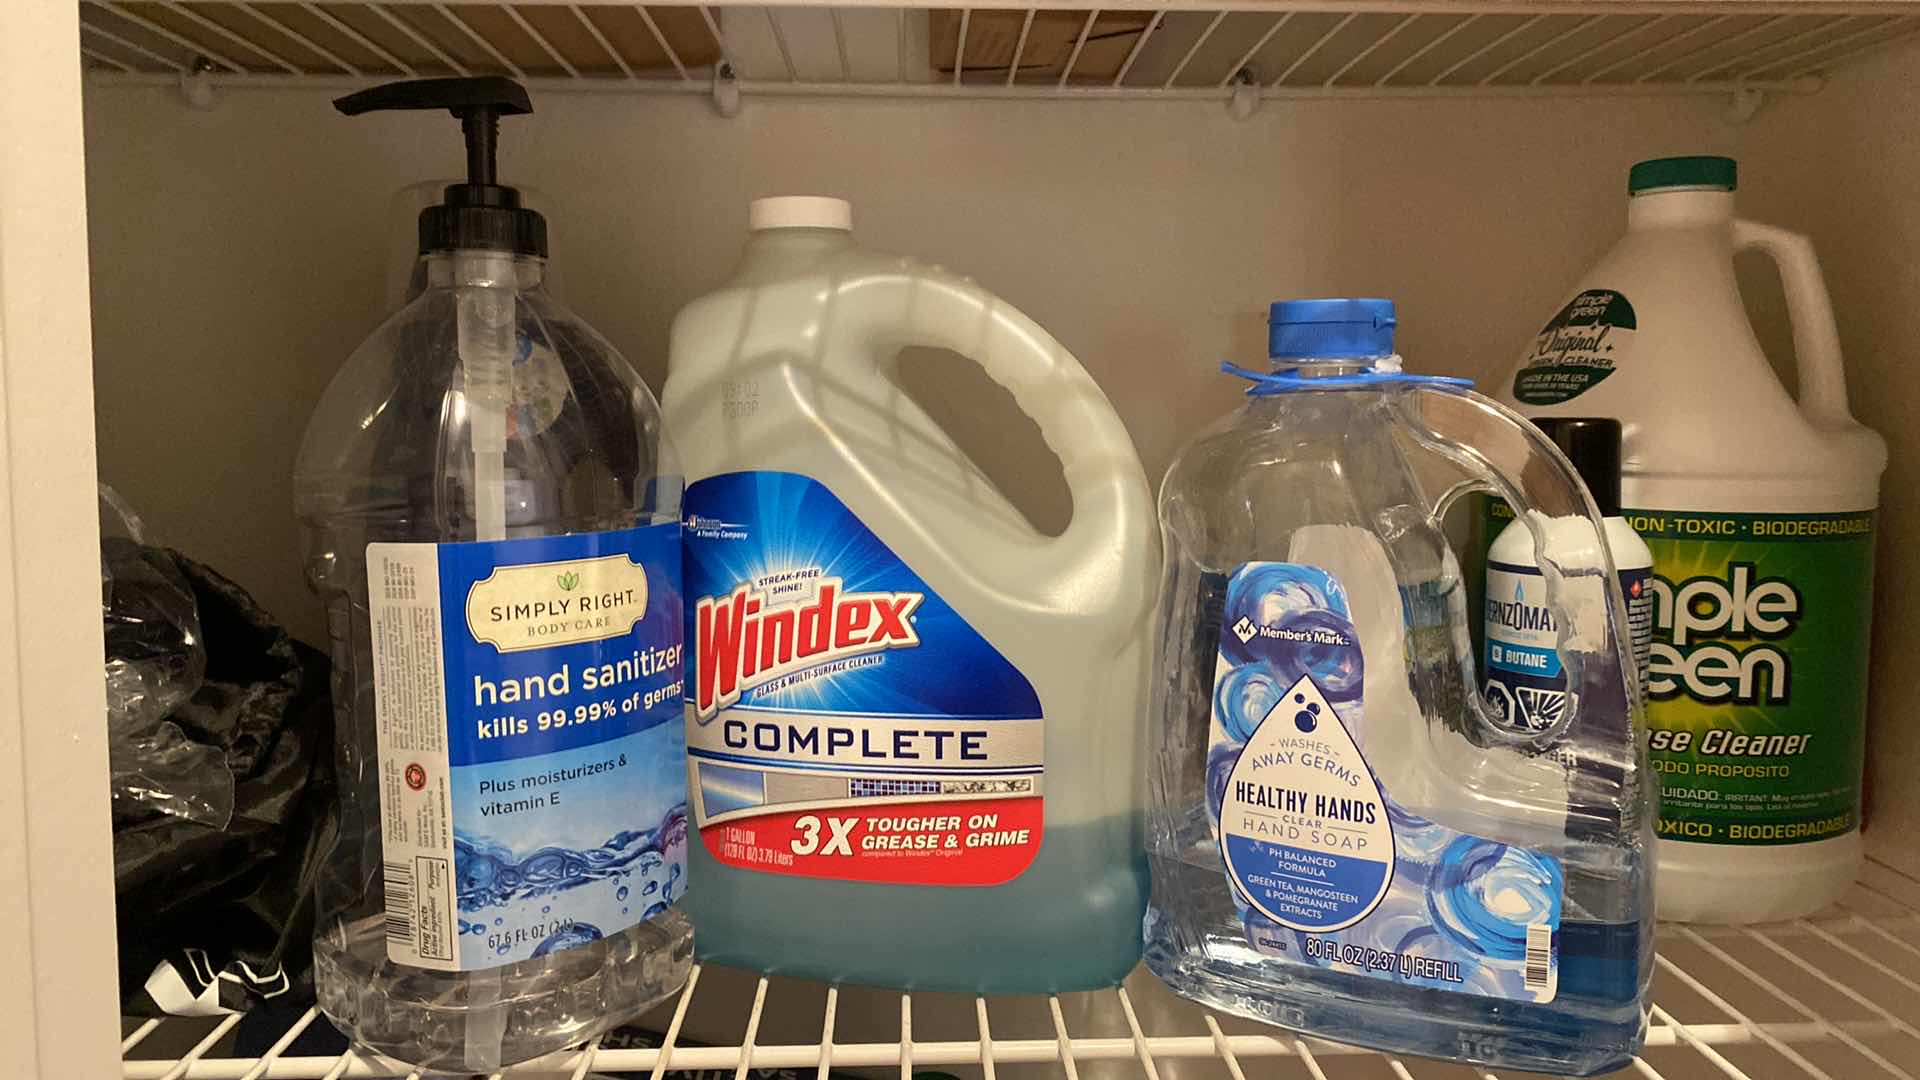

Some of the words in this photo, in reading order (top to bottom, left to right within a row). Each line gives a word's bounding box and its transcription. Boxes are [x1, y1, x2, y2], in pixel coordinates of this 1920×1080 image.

[1565, 356, 1614, 369] CLEANER
[1752, 517, 1872, 537] BIODEGRADABLE
[758, 568, 820, 588] STREAK-FREE
[772, 582, 803, 595] SHINE!
[490, 599, 571, 623] SIMPLY
[579, 589, 635, 613] RIGHT
[527, 622, 569, 638] BODY
[573, 615, 611, 631] CARE
[1259, 626, 1312, 643] Member's
[1313, 633, 1344, 646] Mark
[698, 583, 911, 712] Windex
[1505, 650, 1548, 669] BUTANE
[1648, 643, 1785, 699] een
[474, 663, 570, 707] hand
[581, 642, 682, 691] sanitizer
[756, 682, 780, 698] GLASS
[780, 680, 786, 689] &
[788, 661, 847, 685] MULTI-SURFACE
[848, 654, 883, 670] CLEANER
[477, 715, 529, 740] kills
[536, 699, 617, 731] 99.99%
[621, 691, 640, 713] of
[723, 719, 989, 761] COMPLETE
[1278, 738, 1331, 756] WASHES
[1700, 728, 1813, 756] Cleaner
[479, 779, 516, 795] Plus
[520, 759, 615, 790] moisturizers
[617, 752, 628, 767] &
[1252, 751, 1295, 771] AWAY
[1300, 752, 1361, 788] GERMS
[1652, 760, 1690, 775] ODO
[1695, 761, 1791, 779] PROPOSITO
[479, 793, 545, 818] vitamin
[550, 791, 561, 805] E
[1236, 779, 1308, 814] HEALTHY
[1315, 793, 1376, 825] HANDS
[865, 815, 962, 833] TOUGHER
[967, 813, 999, 830] ON
[1282, 814, 1323, 830] CLEAR
[730, 827, 756, 846] GALLON
[790, 815, 860, 856] 3X
[861, 834, 940, 850] GREASE
[943, 833, 959, 849] &
[964, 829, 1031, 849] GRIME
[1243, 817, 1300, 840] HAND
[1311, 830, 1368, 851] SOAP
[1269, 847, 1283, 858] PH
[1283, 851, 1337, 869] BALANCED
[1278, 860, 1327, 878] FORMULA
[1247, 873, 1277, 889] GREEN
[1295, 884, 1360, 905] MANGOSTEEN
[1265, 889, 1271, 898] &
[1272, 890, 1339, 912] POMEGRANATE
[419, 905, 429, 931] Facts
[428, 896, 437, 933] ingredient
[1280, 903, 1323, 920] EXTRACTS
[420, 931, 431, 955] Drug
[531, 923, 545, 940] OZ
[430, 933, 438, 956] Active
[1305, 937, 1323, 959] 80
[1323, 941, 1342, 962] FL
[1341, 944, 1364, 966] OZ
[1364, 949, 1397, 974] (2.37
[1399, 954, 1413, 978] L)
[1414, 958, 1464, 983] REFILL
